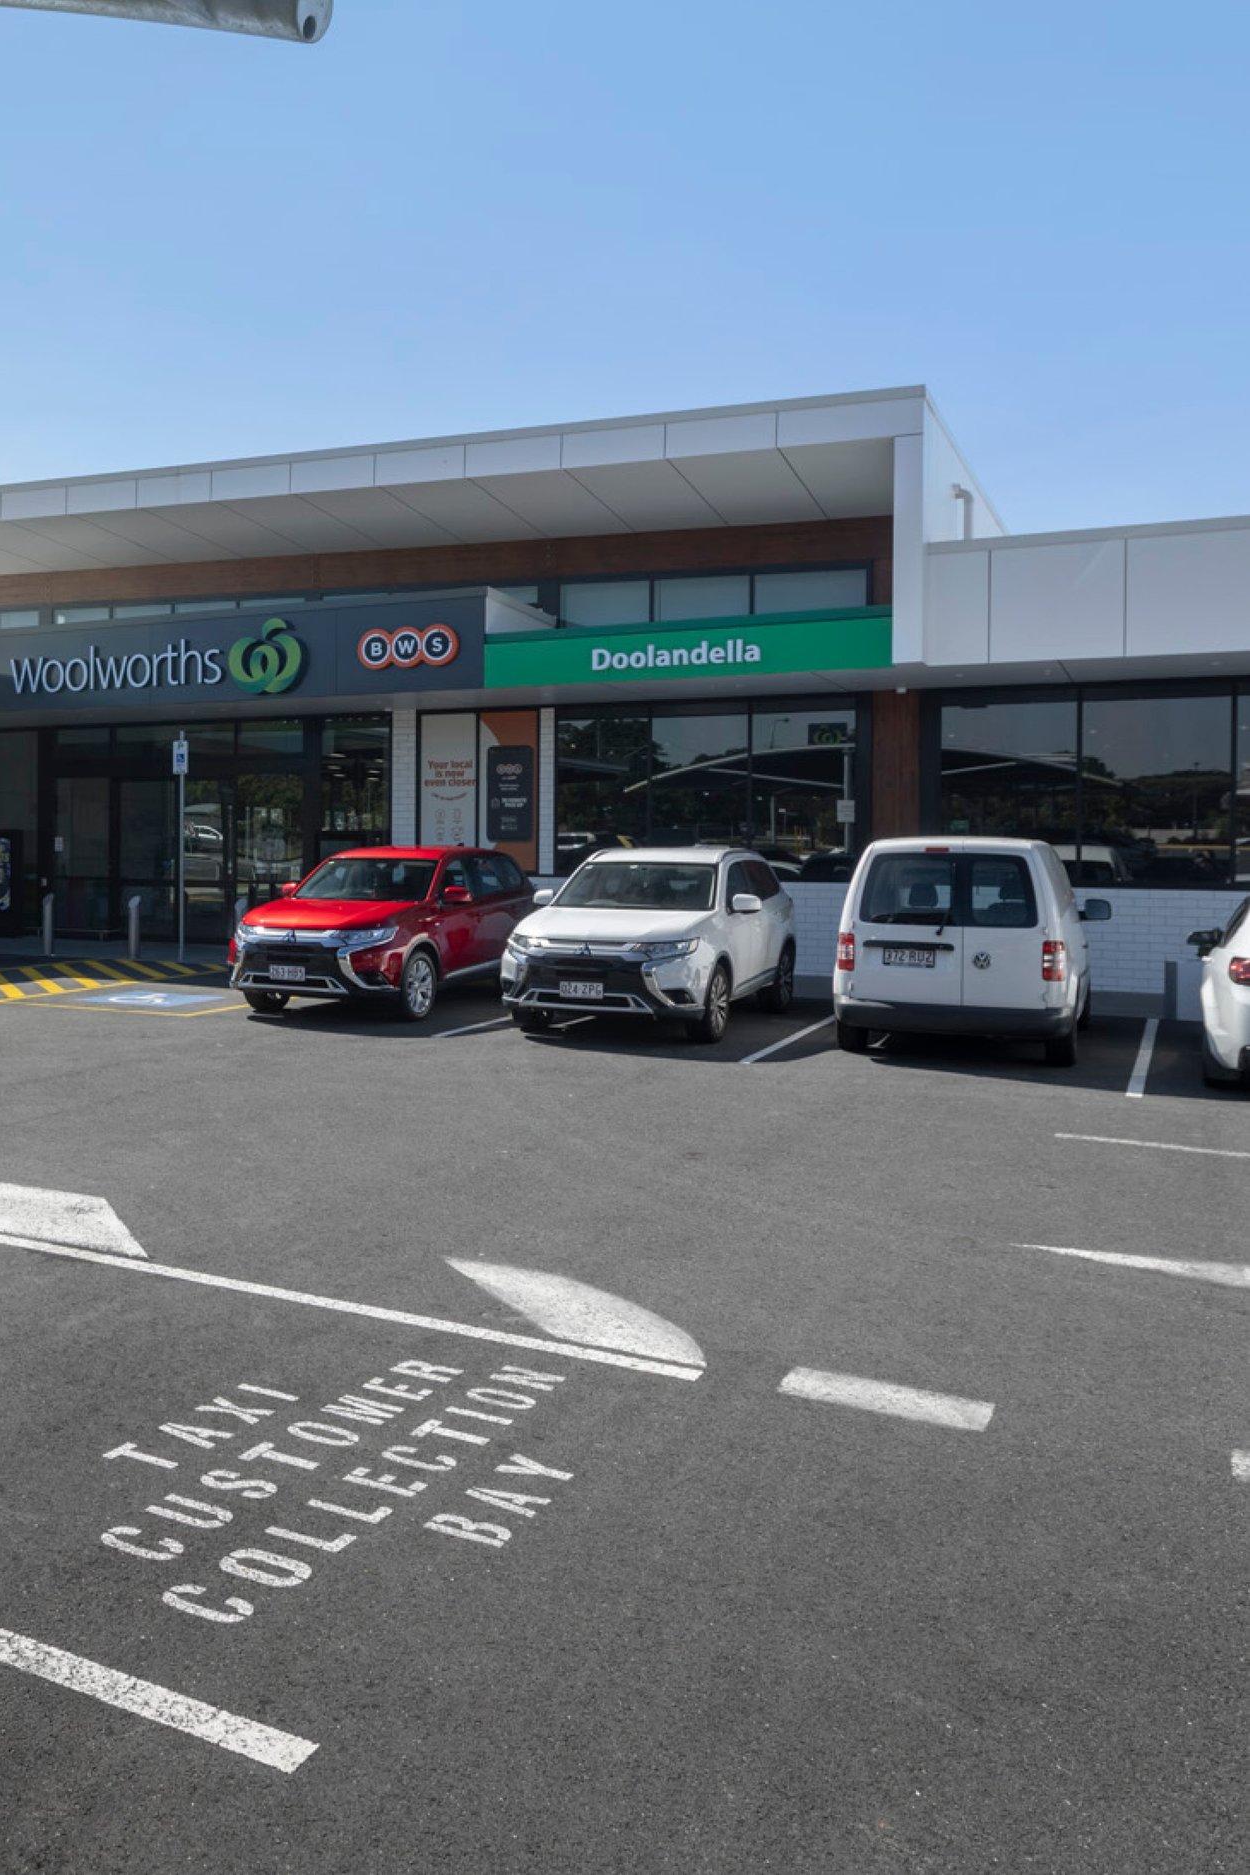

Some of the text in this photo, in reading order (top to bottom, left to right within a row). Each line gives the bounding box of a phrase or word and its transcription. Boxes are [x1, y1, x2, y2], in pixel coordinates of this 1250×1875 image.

[591, 638, 762, 671] Doolandella
[100, 1359, 464, 1561] CUSTOMER
[102, 1383, 300, 1468] TAXI
[162, 1365, 566, 1623] COLLECTION
[423, 1453, 574, 1548] BAY
